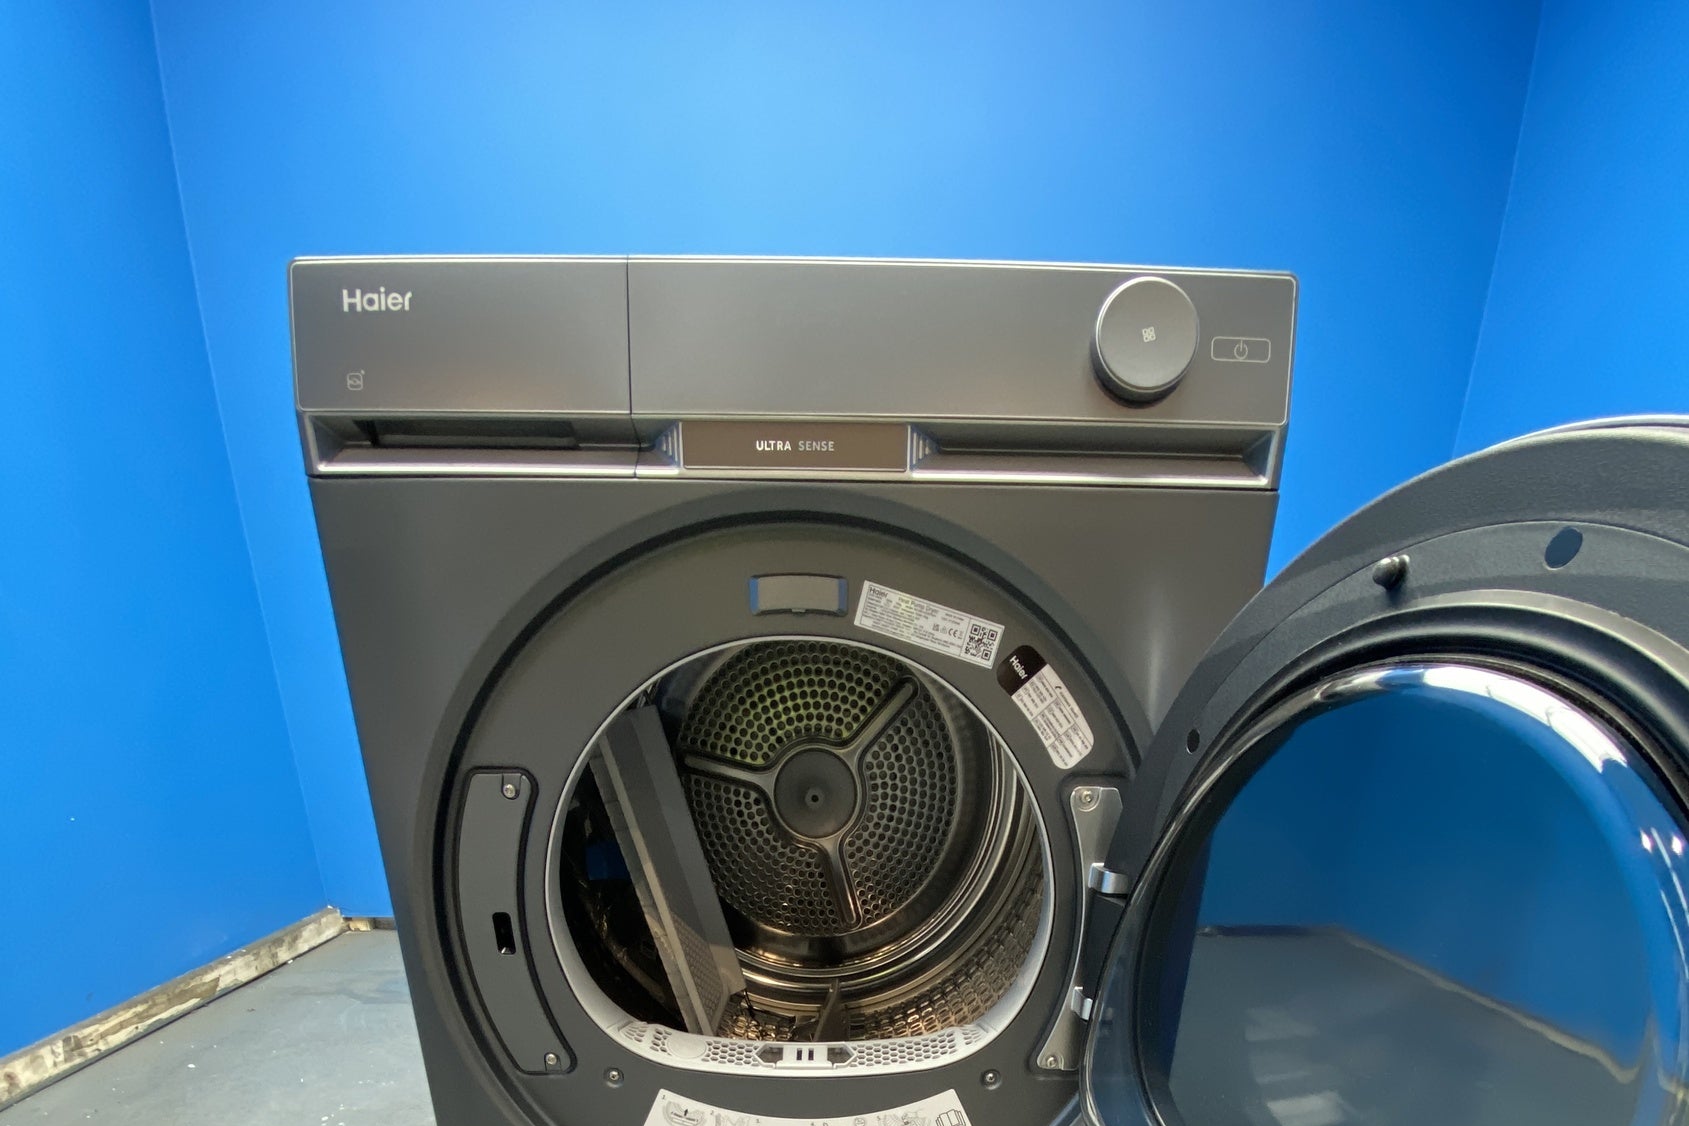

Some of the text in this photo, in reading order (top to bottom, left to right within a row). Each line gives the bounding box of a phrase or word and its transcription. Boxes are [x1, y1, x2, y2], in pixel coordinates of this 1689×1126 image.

[342, 286, 412, 312] Haier
[756, 440, 834, 452] ULTRA SENSE
[869, 586, 888, 598] Haier
[1009, 655, 1028, 680] Haier
